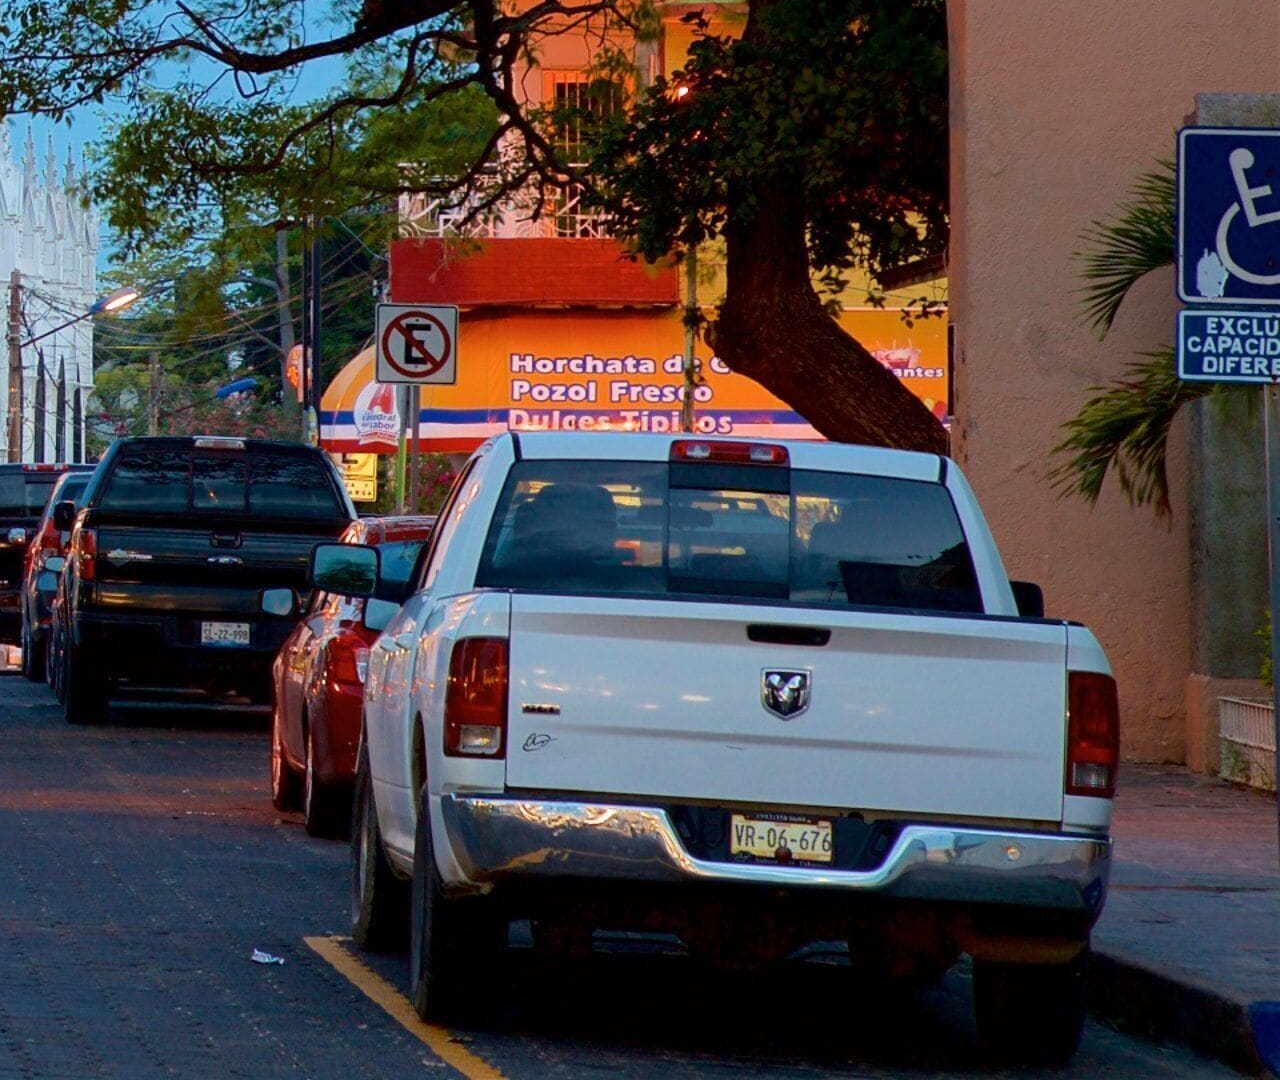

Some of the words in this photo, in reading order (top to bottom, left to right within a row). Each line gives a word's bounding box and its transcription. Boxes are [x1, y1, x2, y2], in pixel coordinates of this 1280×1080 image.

[1206, 317, 1279, 336] EXCLU
[404, 323, 432, 365] E
[1187, 336, 1280, 356] CAPACID
[511, 354, 655, 374] Horchata
[892, 368, 944, 377] antes
[1202, 356, 1280, 375] DIFERE
[511, 379, 597, 402] Pozol
[509, 409, 610, 431] Dulces
[619, 410, 733, 433] Típios
[735, 824, 832, 852] VR-06-676
